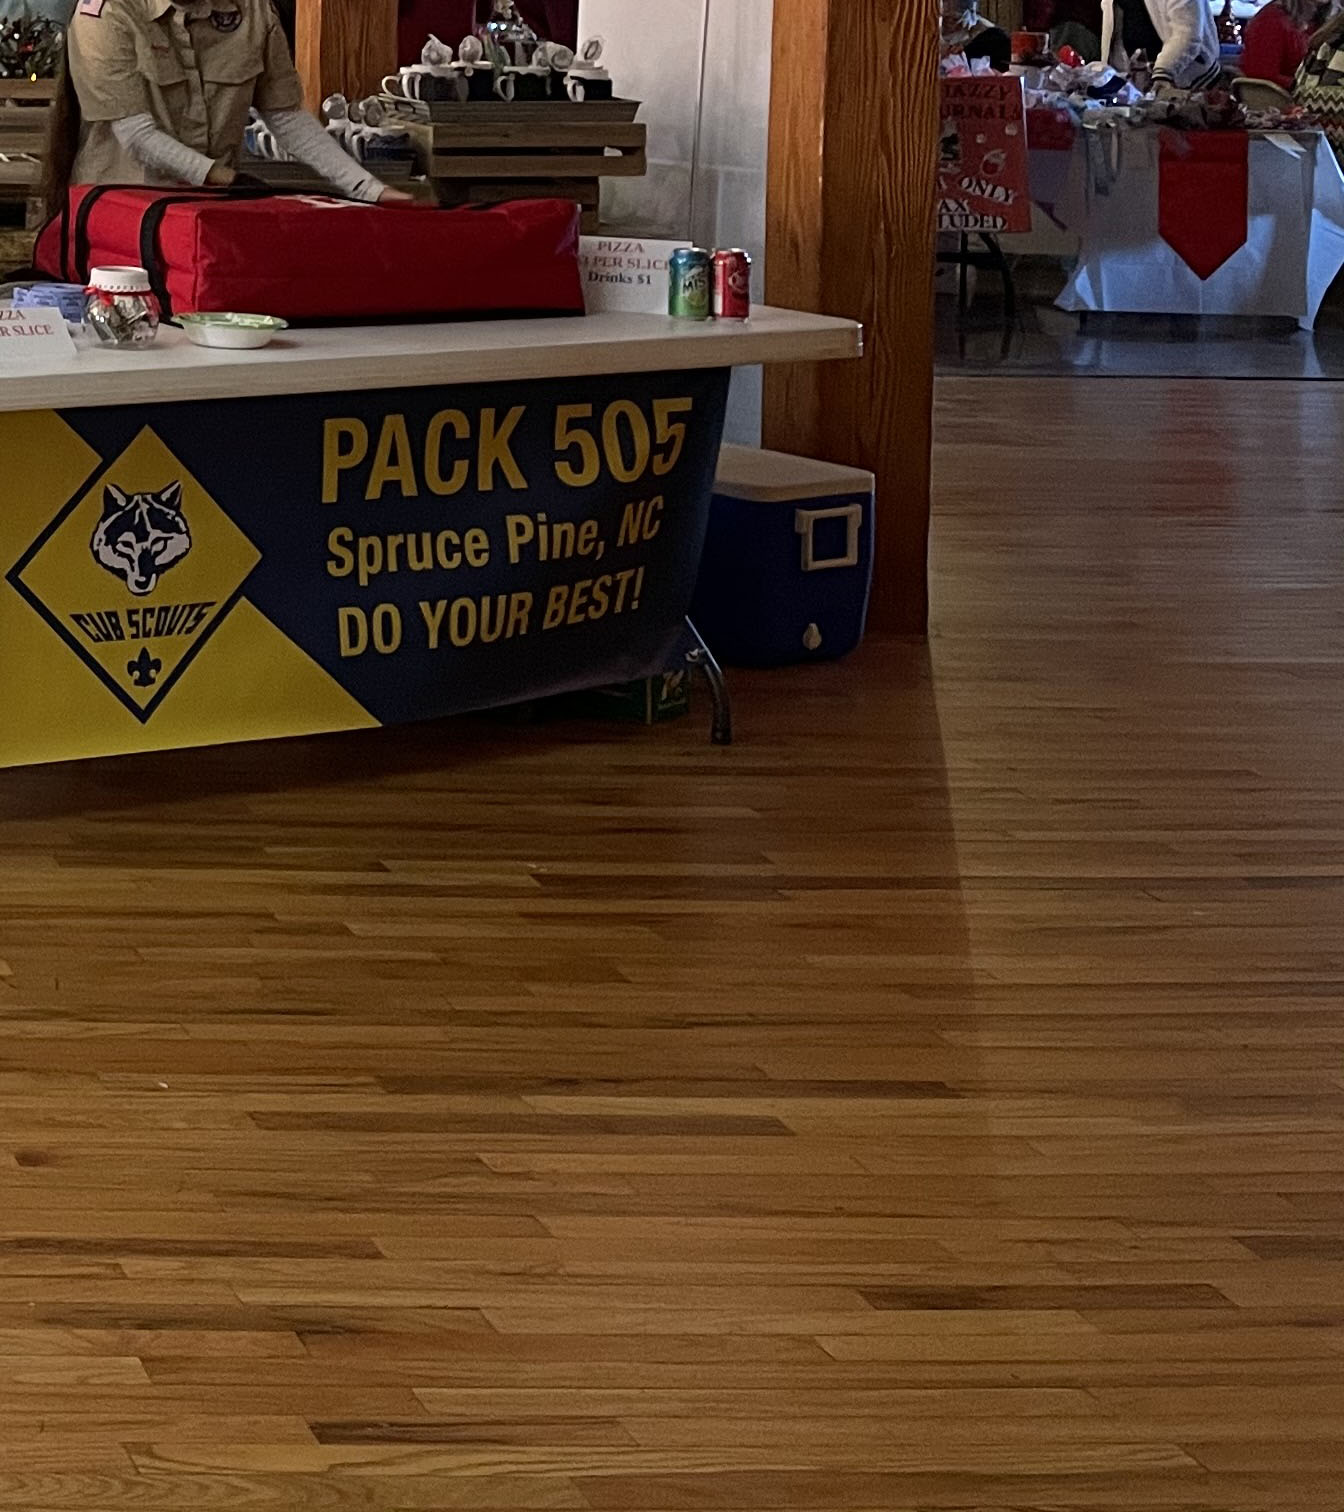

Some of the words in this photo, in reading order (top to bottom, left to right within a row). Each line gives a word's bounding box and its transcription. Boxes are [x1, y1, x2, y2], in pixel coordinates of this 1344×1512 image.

[938, 200, 968, 212] AX
[599, 242, 644, 253] PIZZA
[593, 256, 622, 267] PER
[588, 272, 632, 283] Drinks
[638, 275, 651, 284] $1
[683, 279, 706, 294] MIS
[13, 325, 54, 336] SLICE
[322, 406, 528, 504] PACK
[554, 397, 693, 487] 505
[326, 527, 490, 586] Spruce
[506, 513, 604, 563] Pine,
[616, 495, 664, 547] NC
[338, 603, 402, 657] DO
[419, 591, 533, 650] YOUR
[543, 567, 645, 630] BEST!
[69, 611, 125, 642] CUB
[126, 602, 217, 639] SCOUTS
